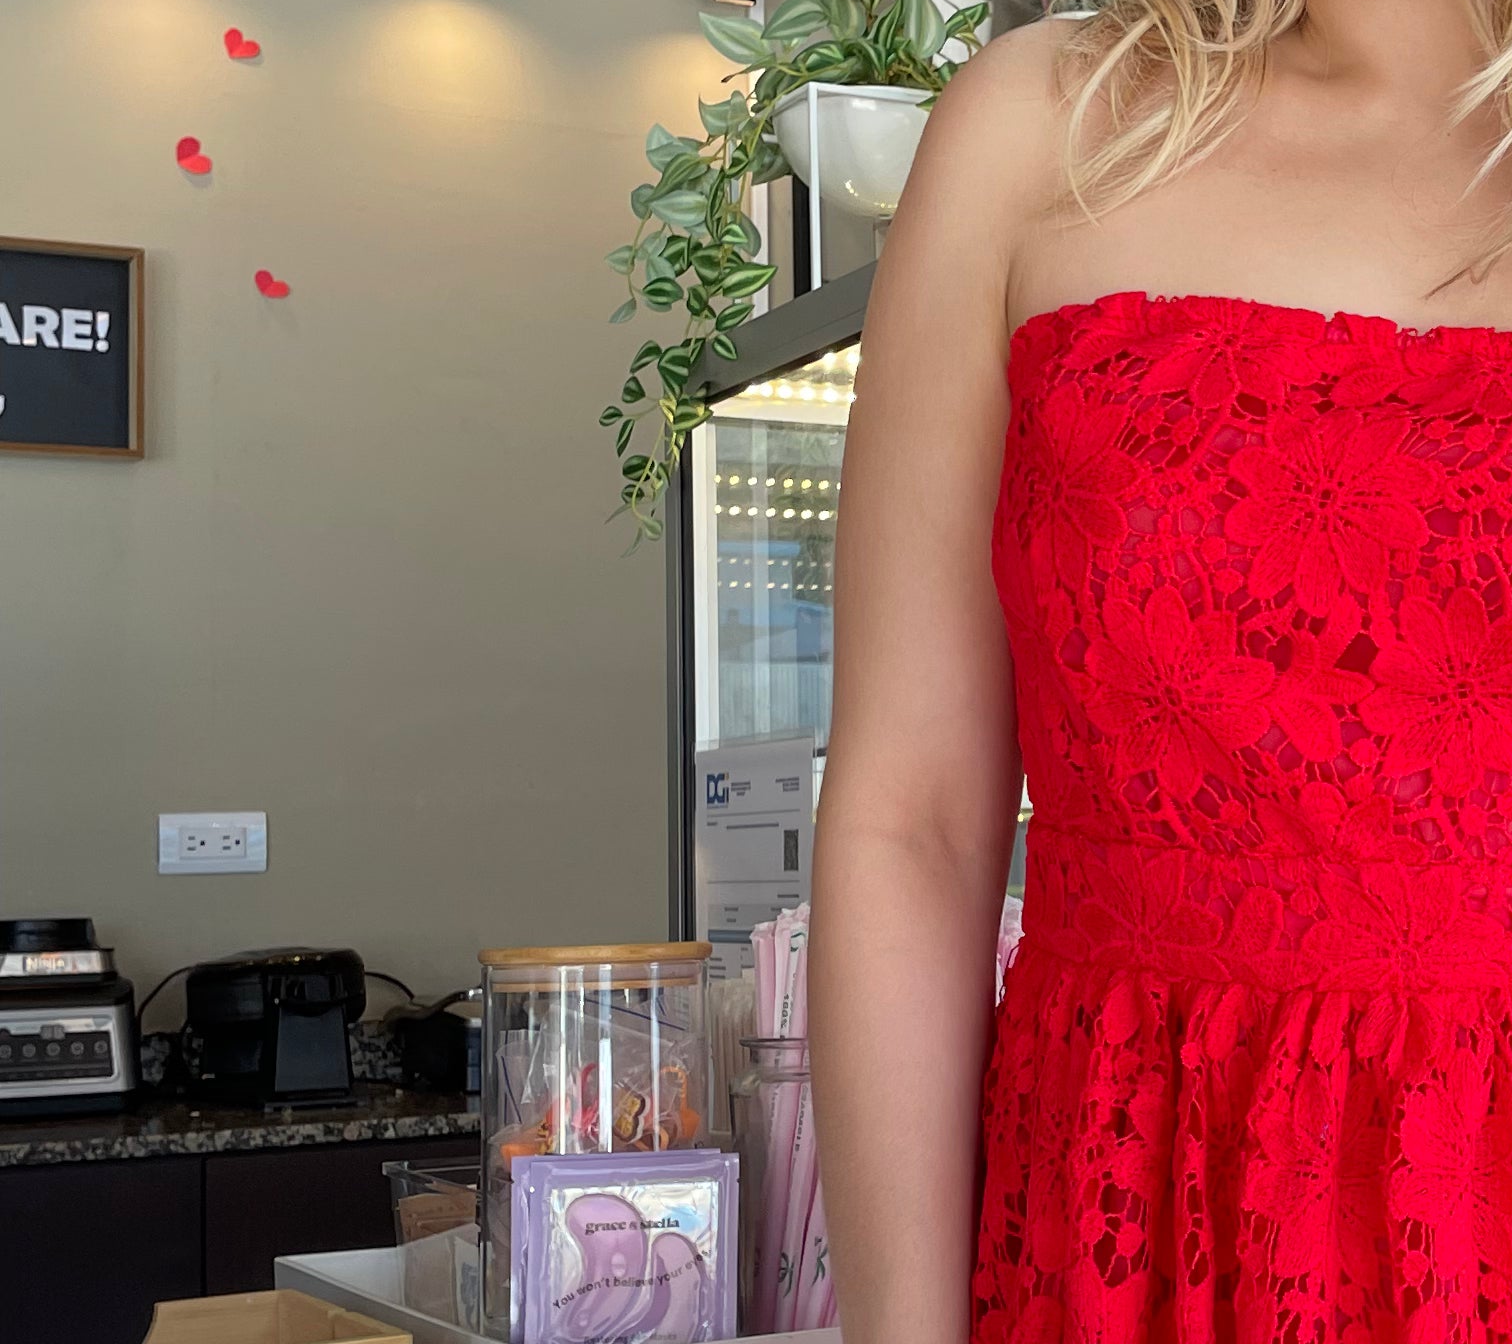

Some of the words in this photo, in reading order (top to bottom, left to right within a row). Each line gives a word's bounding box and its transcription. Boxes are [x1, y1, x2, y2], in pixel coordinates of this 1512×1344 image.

[585, 1222, 627, 1235] grace
[553, 1293, 575, 1309] You
[576, 1277, 610, 1295] won't
[613, 1276, 654, 1288] believe
[656, 1266, 683, 1286] your
